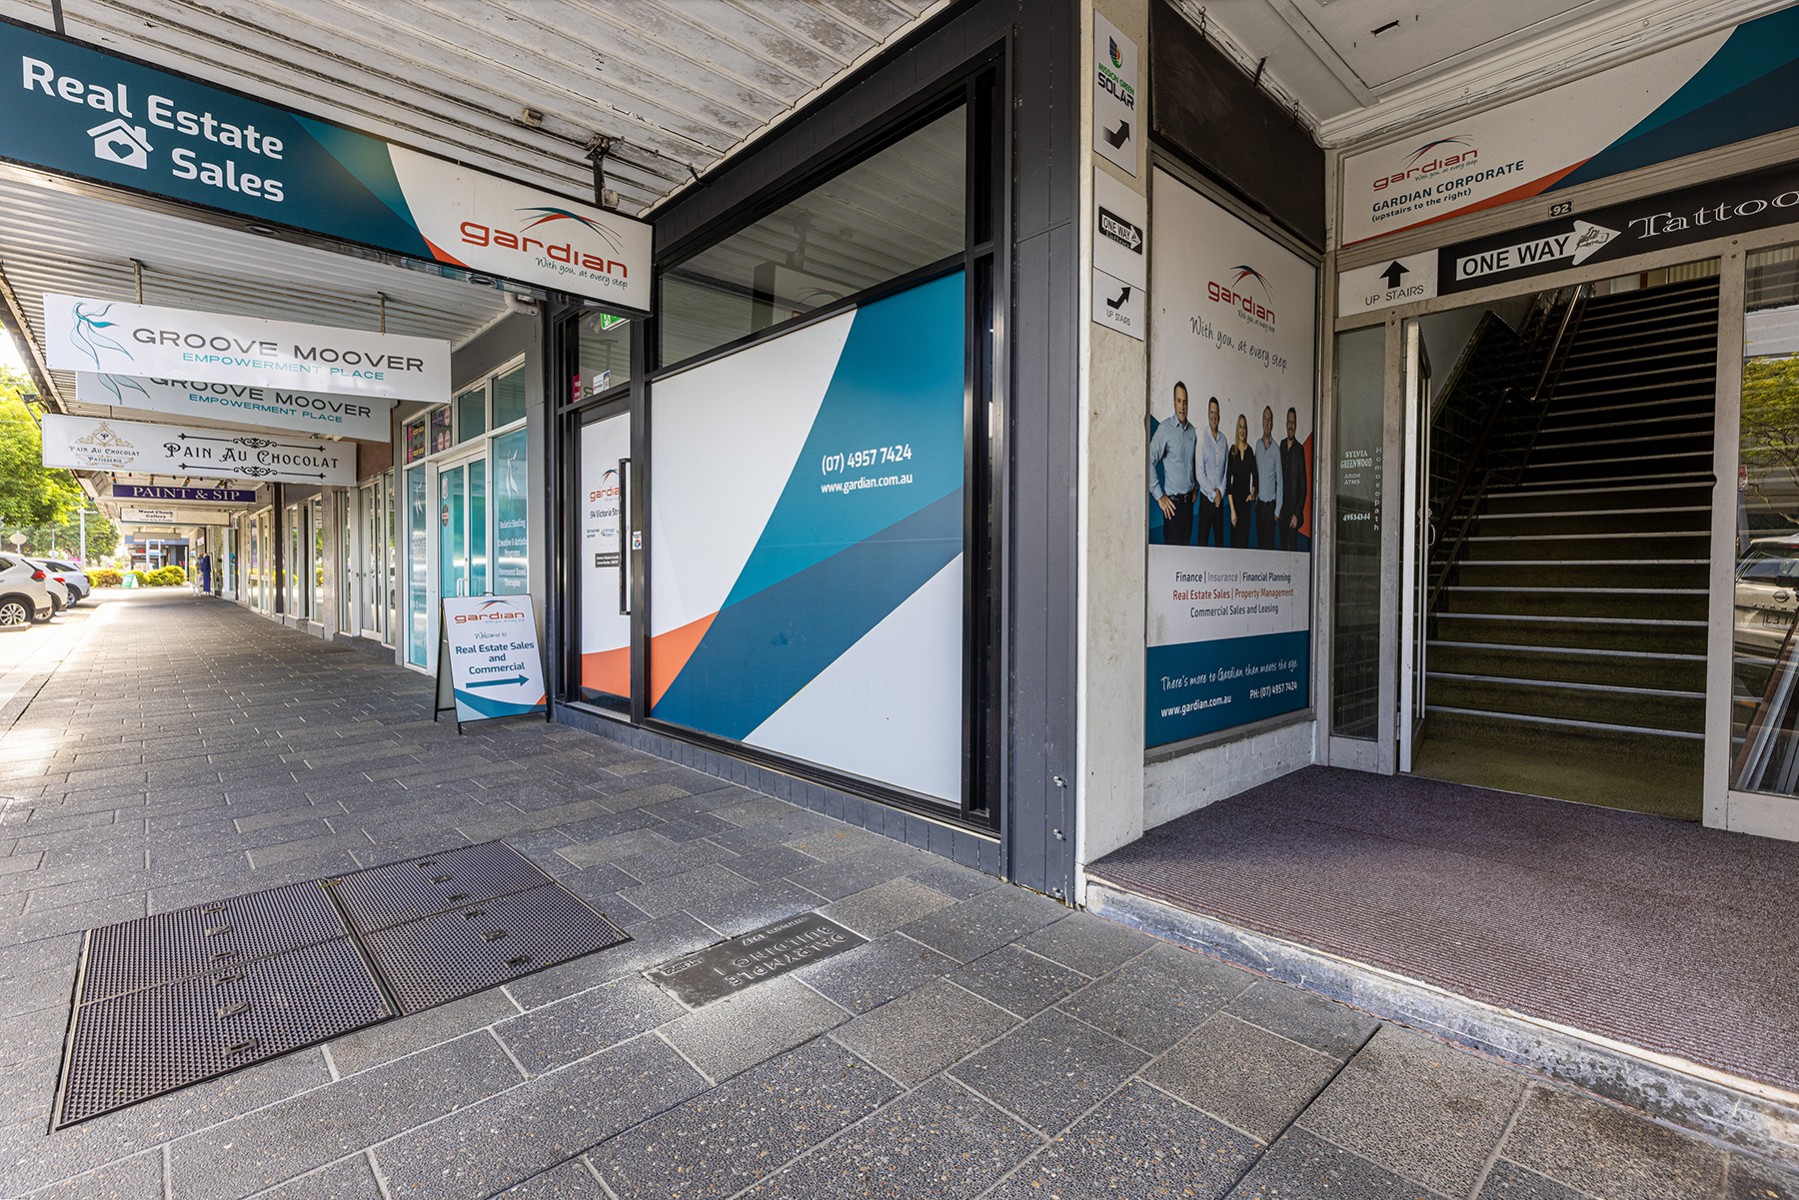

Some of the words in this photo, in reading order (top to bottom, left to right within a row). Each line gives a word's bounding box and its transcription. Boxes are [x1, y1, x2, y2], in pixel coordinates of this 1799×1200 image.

[1098, 62, 1119, 84] MISSION
[1120, 79, 1135, 96] GREEN
[1098, 72, 1134, 111] SOLAR
[22, 55, 133, 119] Real
[148, 94, 286, 160] Estate
[172, 147, 287, 203] Sales
[1373, 149, 1478, 192] gardian
[1372, 187, 1432, 213] GARDIAN
[1436, 160, 1525, 195] CORPORATE
[1371, 205, 1412, 223] (upstairs
[1413, 203, 1424, 211] to
[1426, 196, 1442, 208] the
[1443, 187, 1472, 206] right)
[1551, 203, 1570, 215] 92
[1104, 217, 1117, 234] ONE
[460, 221, 628, 279] gardian
[1462, 252, 1511, 277] ONE
[1516, 234, 1571, 265] WAY
[535, 257, 557, 271] With
[578, 270, 588, 278] at
[589, 273, 610, 287] every
[1207, 281, 1275, 325] gardian
[1365, 294, 1380, 306] UP
[1385, 284, 1424, 302] STAIRS
[1106, 309, 1114, 318] UP
[1114, 313, 1130, 326] STAIRS
[132, 327, 279, 358] GROOVE
[293, 344, 424, 374] MOOVER
[1190, 315, 1214, 340] With
[1215, 331, 1234, 349] you,
[1237, 340, 1247, 354] at
[1249, 345, 1270, 368] every
[182, 352, 322, 375] EMPOWERMENT
[329, 366, 385, 381] PLACE
[149, 377, 264, 401] GROOVE
[275, 391, 371, 418] MOOVER
[188, 393, 295, 417] EMPOWERMENT
[301, 409, 343, 423] PLACE
[105, 448, 140, 457] CHOCOLAT
[163, 442, 212, 459] PAIN
[218, 447, 247, 463] AU
[256, 449, 339, 469] CHOCOLAT
[821, 452, 845, 476] (07)
[846, 449, 878, 468] 4957
[879, 443, 912, 464] 7424
[1340, 458, 1372, 469] GREENWOOD
[1345, 450, 1368, 459] SYLVIA
[133, 487, 190, 499] PAINT
[195, 490, 209, 500] &
[212, 490, 240, 501] SIP
[590, 486, 620, 502] gardia
[820, 473, 913, 494] www.gardian.com.au
[596, 508, 612, 518] Victoria
[1175, 571, 1203, 583] Finance
[1208, 572, 1238, 582] Insurance
[1242, 572, 1267, 582] Financial
[1268, 572, 1291, 584] Planning
[1172, 589, 1189, 600] Real
[1190, 589, 1211, 600] Estate
[1213, 589, 1230, 600] Sales
[1234, 589, 1260, 600] Property
[1260, 588, 1294, 599] Management
[454, 611, 525, 624] gardian
[1190, 606, 1229, 618] Commercial
[1229, 605, 1246, 615] Sales
[1246, 604, 1258, 614] and
[1258, 603, 1279, 615] Leasing
[455, 644, 477, 655] Real
[478, 643, 509, 653] Estate
[510, 641, 535, 650] Sales
[474, 631, 501, 640] Welcome
[468, 662, 526, 675] Commercial
[488, 653, 507, 662] and
[1160, 675, 1188, 691] There's
[1189, 677, 1207, 686] more
[1209, 673, 1216, 683] to
[1217, 666, 1244, 681] Gardian
[1244, 664, 1259, 676] than
[1259, 661, 1277, 673] meets
[1277, 659, 1287, 671] the
[1249, 688, 1260, 700] PH:
[1260, 685, 1271, 699] (07)
[1271, 682, 1285, 695] 4957
[1285, 680, 1298, 692] 7424
[1160, 694, 1232, 718] www.gardian.com.au
[733, 925, 833, 967] BUILDING
[724, 933, 848, 986] DALRYMPLE
